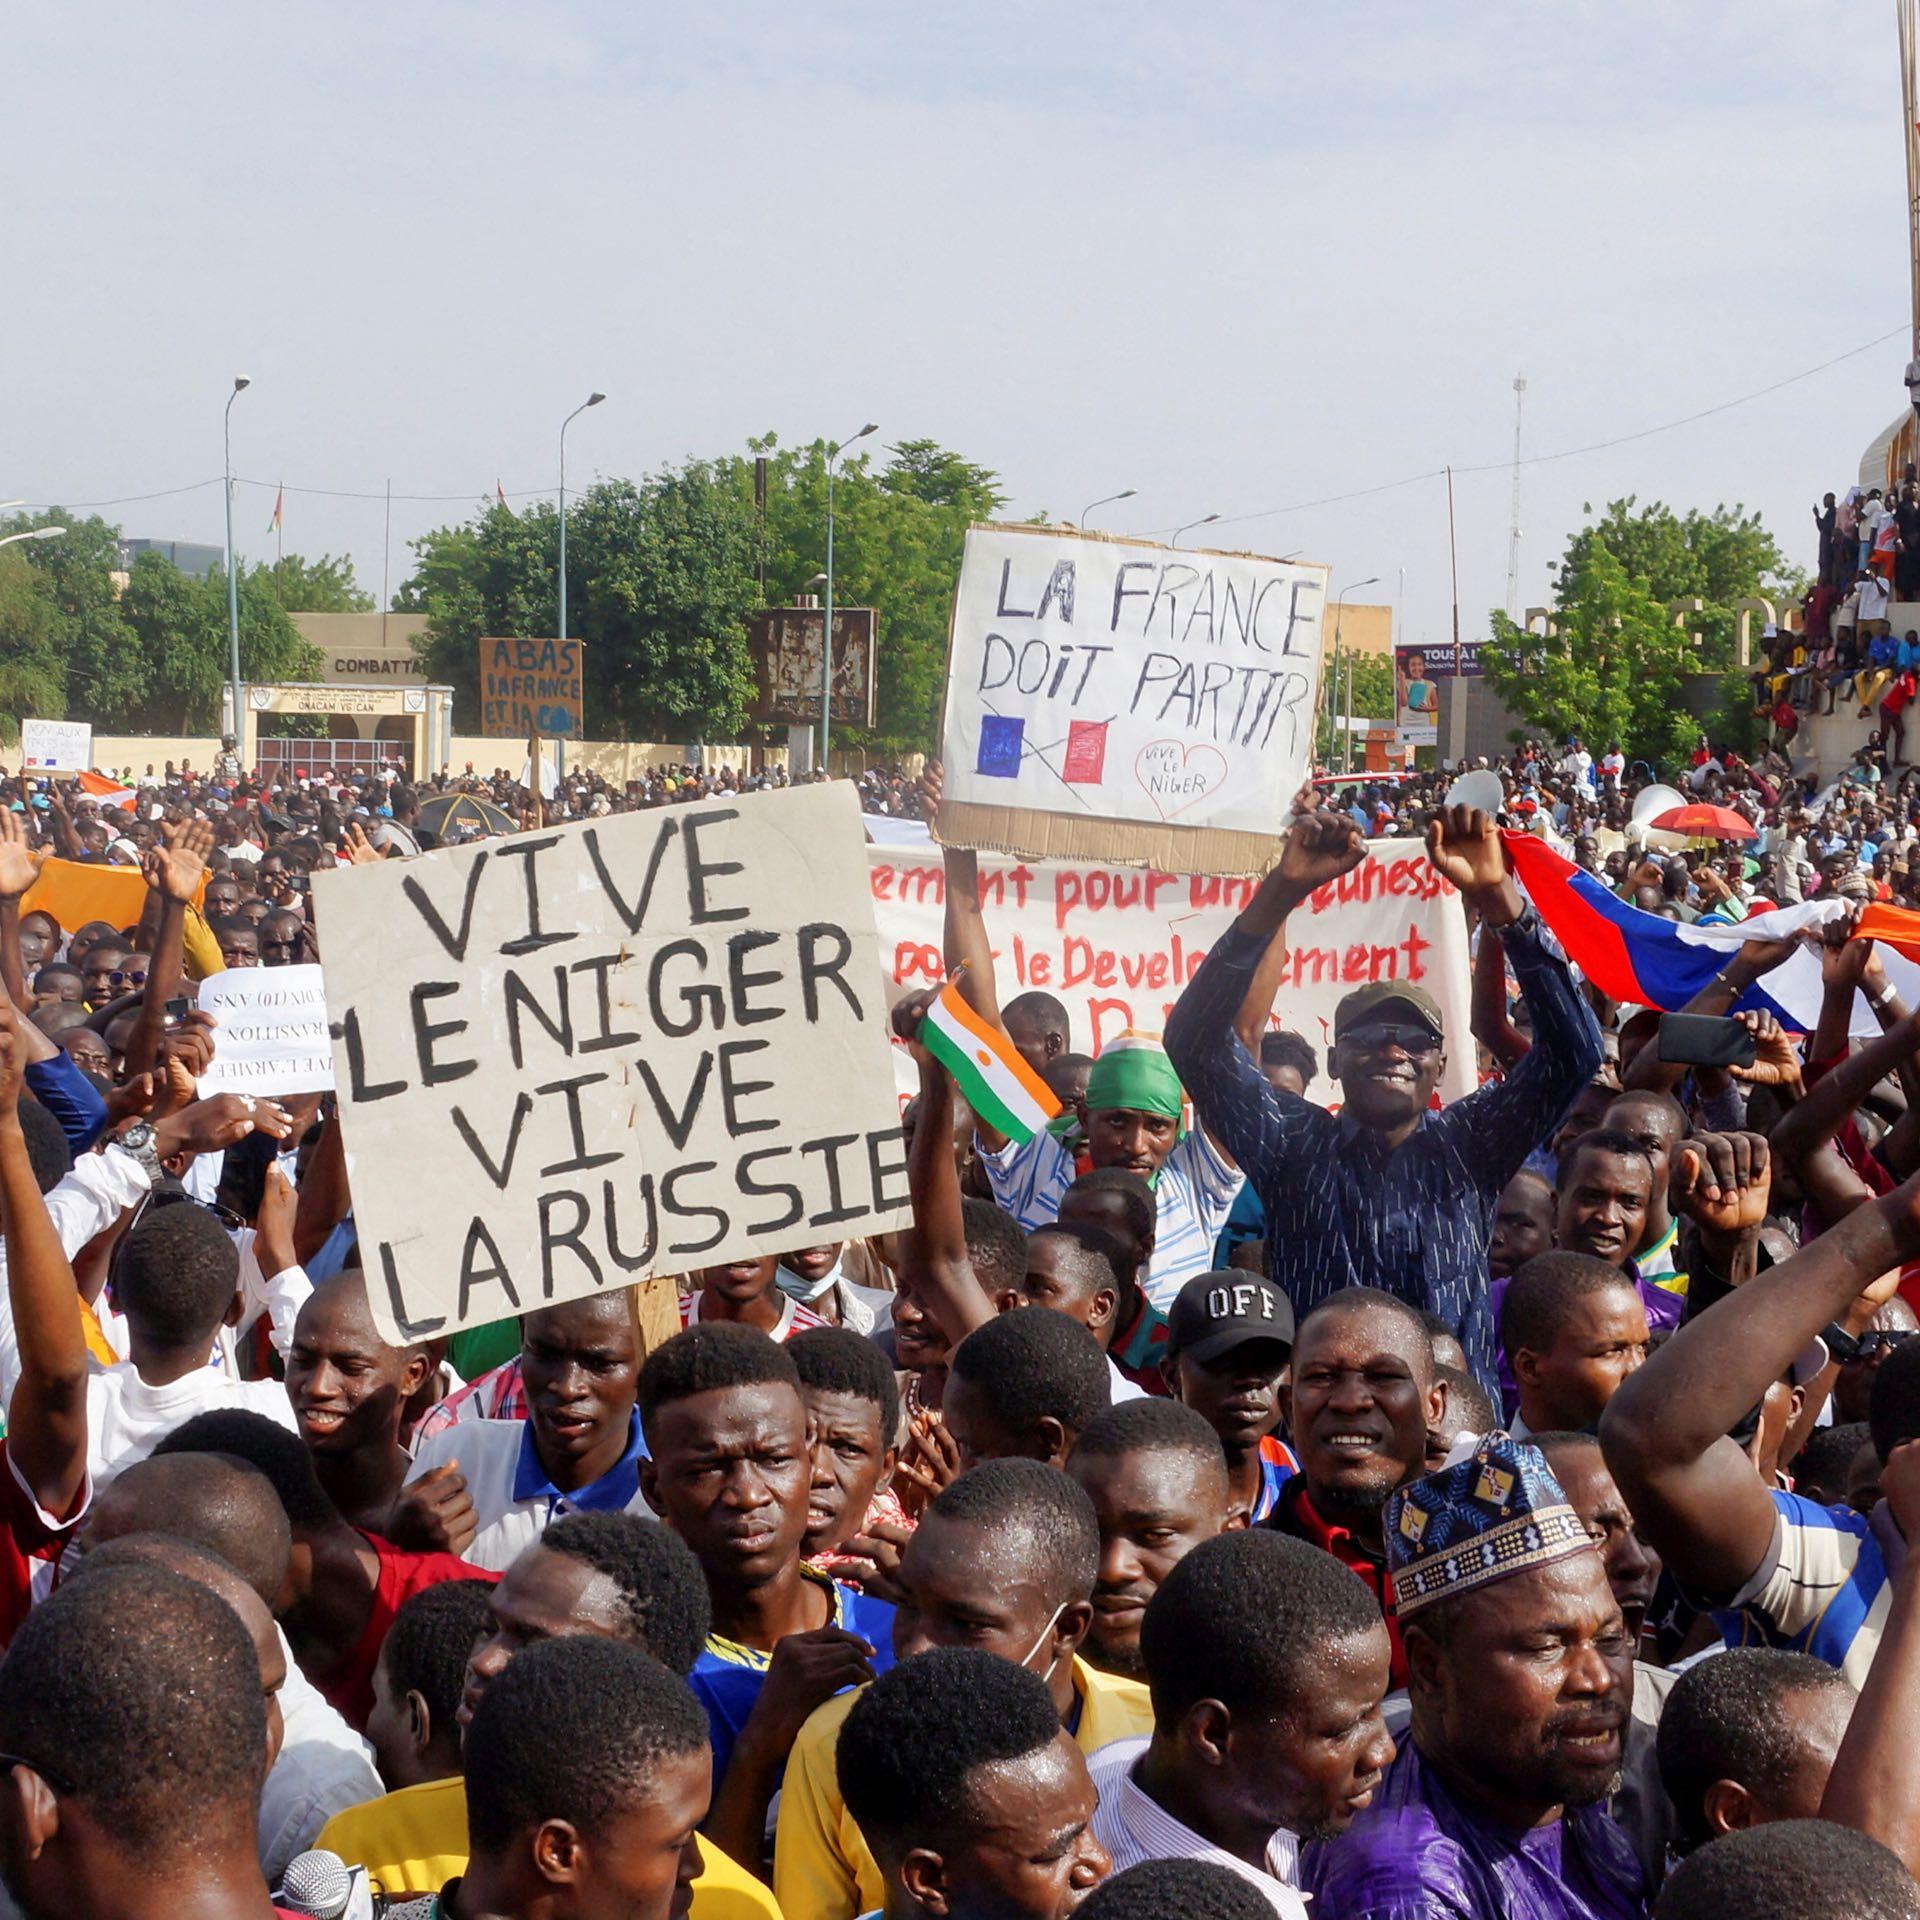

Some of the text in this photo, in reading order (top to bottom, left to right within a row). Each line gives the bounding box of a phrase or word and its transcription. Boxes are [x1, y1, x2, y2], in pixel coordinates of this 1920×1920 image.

[996, 558, 1321, 657] LA FRANCE
[1163, 761, 1178, 772] LE
[401, 809, 750, 962] VIVE
[1055, 868, 1179, 931] pour
[1189, 876, 1262, 912] un
[1012, 933, 1051, 987] le
[213, 992, 251, 1008] ANS
[227, 1021, 323, 1041] RANSITION
[450, 1039, 781, 1190] VIVE
[1208, 1284, 1274, 1319] OFF
